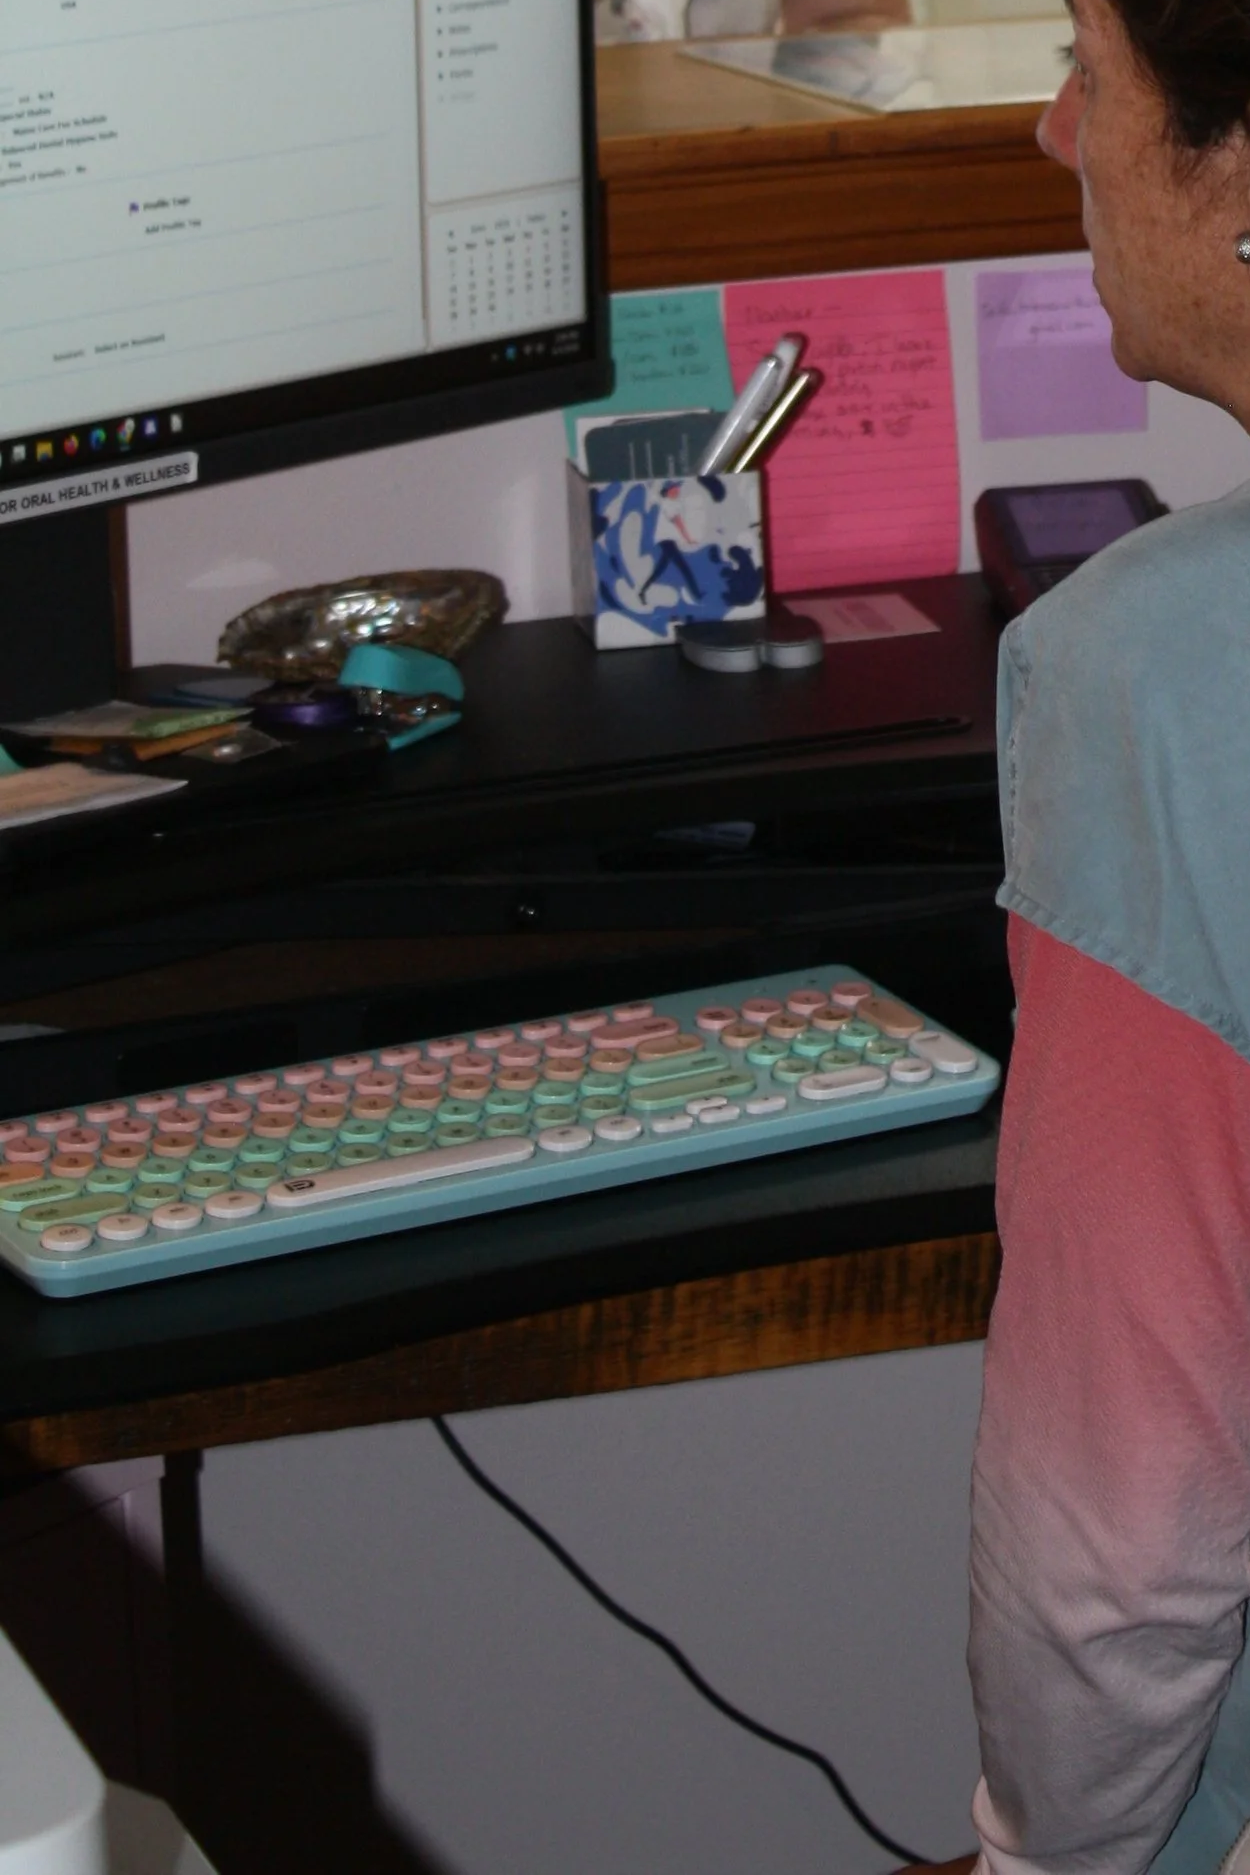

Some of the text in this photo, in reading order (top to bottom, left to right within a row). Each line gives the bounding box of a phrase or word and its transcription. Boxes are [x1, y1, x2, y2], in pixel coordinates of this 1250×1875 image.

[21, 492, 56, 510] ORAL
[58, 479, 109, 502] HEALTH
[111, 477, 121, 490] &
[124, 462, 190, 486] WELLNESS
